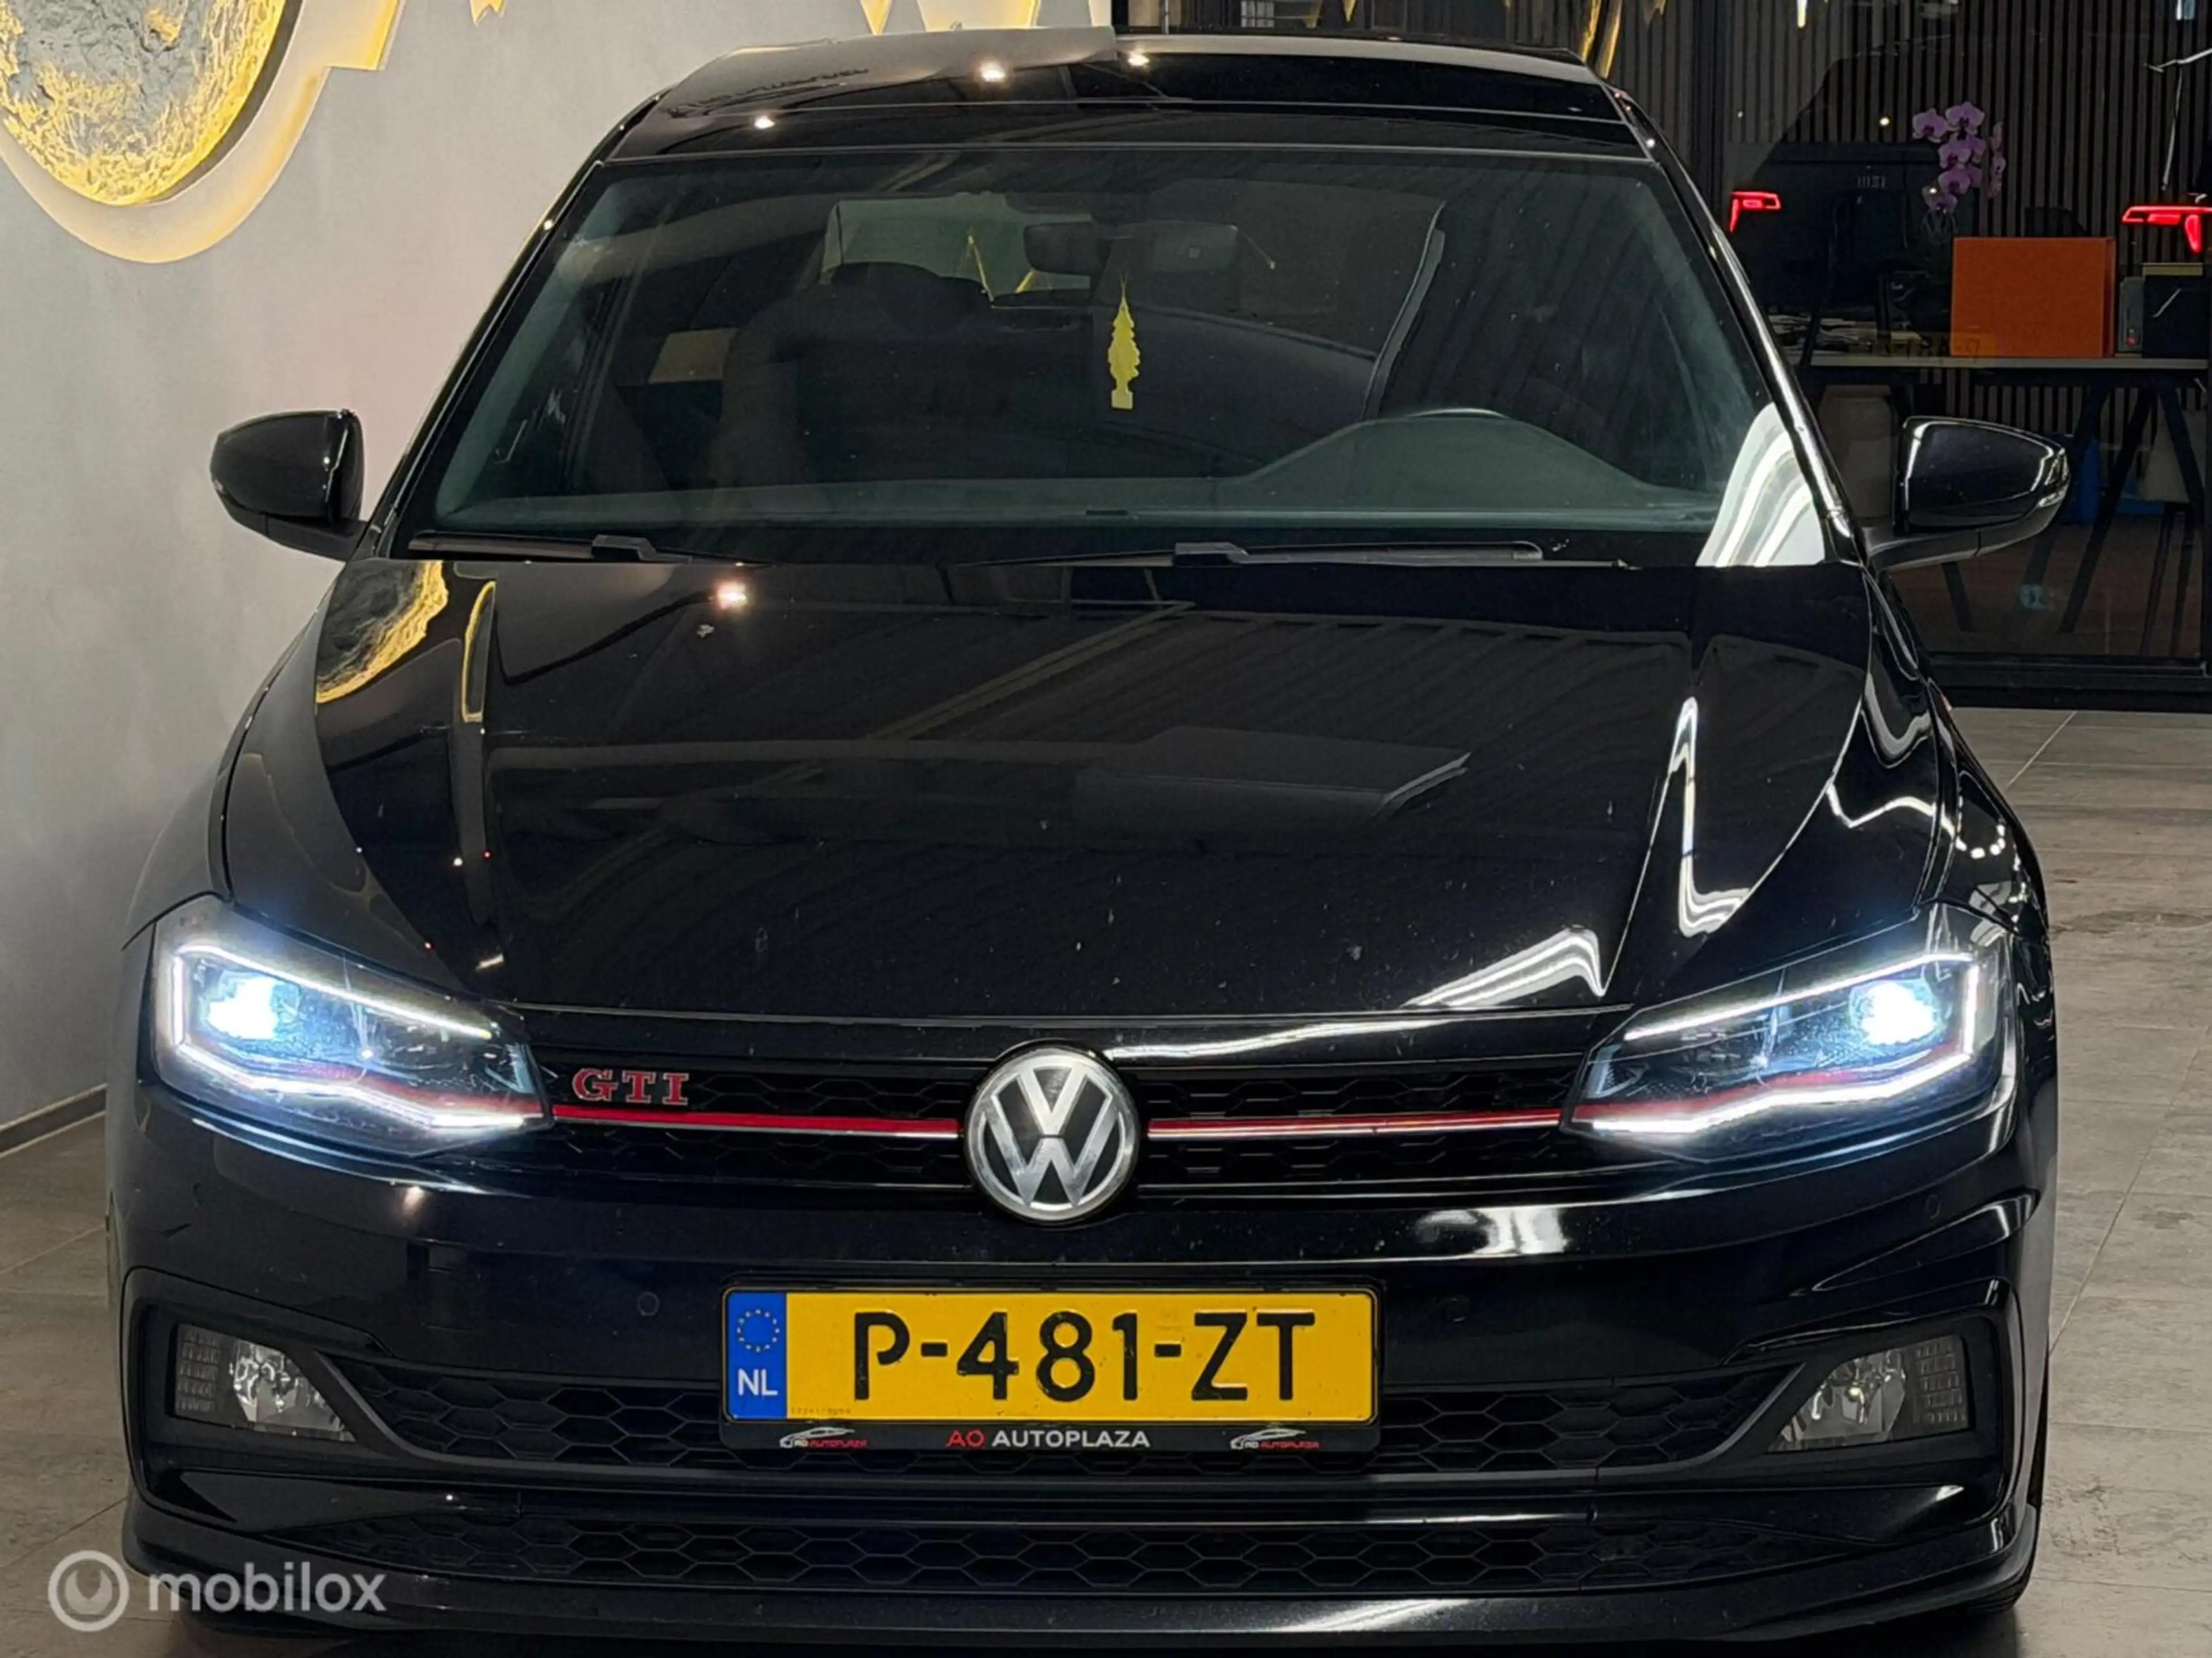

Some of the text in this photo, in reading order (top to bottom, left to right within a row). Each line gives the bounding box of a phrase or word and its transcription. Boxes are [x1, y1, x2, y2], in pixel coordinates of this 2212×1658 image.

[573, 1068, 690, 1106] GTI
[978, 1060, 1123, 1209] VW
[854, 1310, 1316, 1402] P-481-ZT
[737, 1369, 778, 1397] NL
[946, 1429, 1150, 1449] AO AUTOPLAZA
